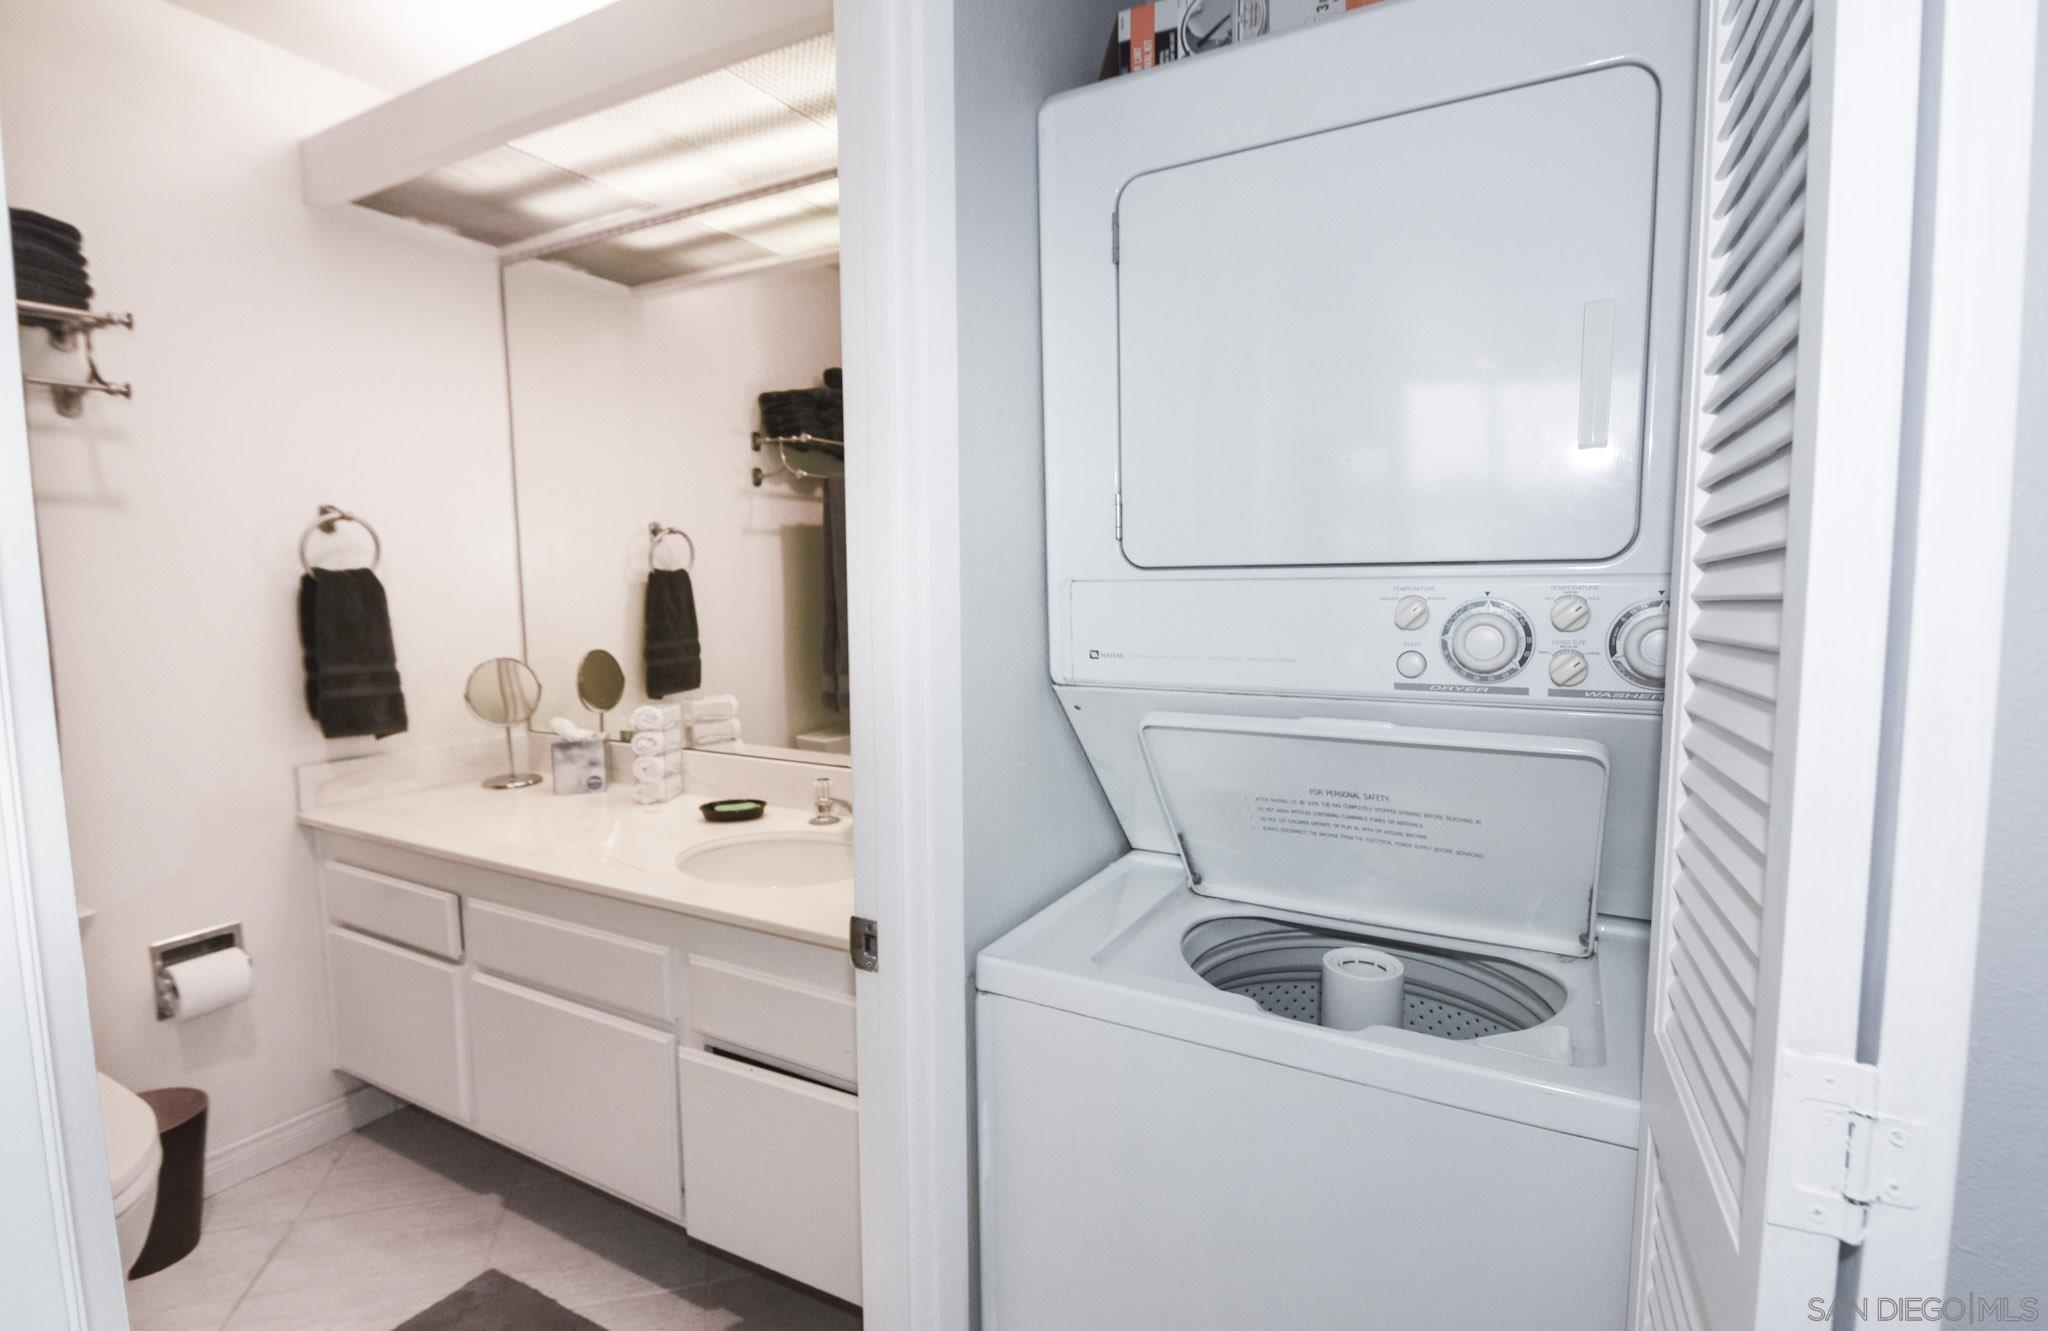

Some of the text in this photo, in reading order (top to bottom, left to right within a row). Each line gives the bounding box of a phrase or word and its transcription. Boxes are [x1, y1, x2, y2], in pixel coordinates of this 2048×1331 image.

[1429, 685, 1490, 693] DRYER
[1309, 788, 1390, 801] FOR PERSONAL SAFETY
